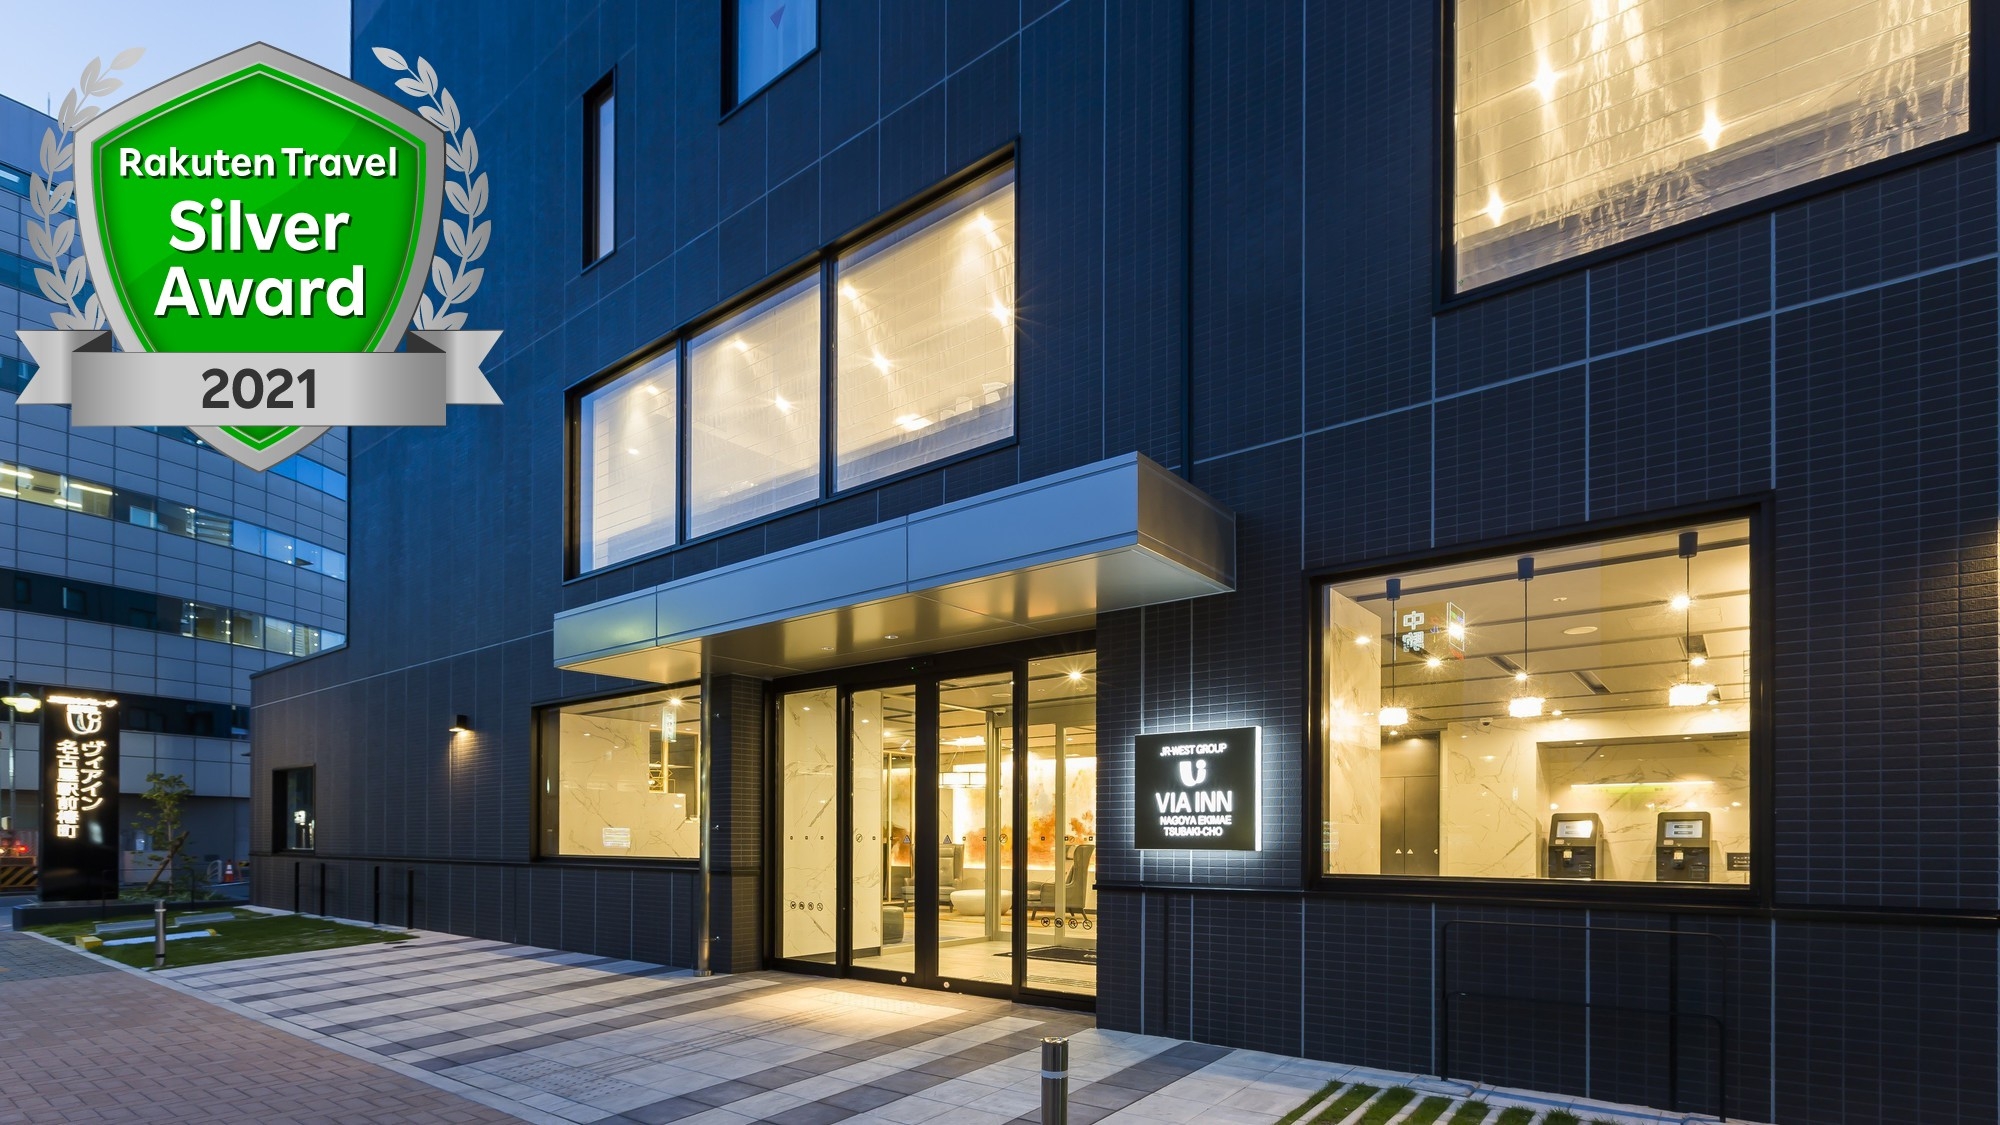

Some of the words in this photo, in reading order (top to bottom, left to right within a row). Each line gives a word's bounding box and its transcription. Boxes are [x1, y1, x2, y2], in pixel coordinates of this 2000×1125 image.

[1160, 745, 1196, 757] JR-WEST
[1196, 743, 1228, 755] GROUP
[81, 740, 107, 811] ヴィアイン
[1155, 791, 1192, 813] VIA
[1195, 790, 1233, 813] INN
[1160, 815, 1197, 826] NAGOYA
[1198, 814, 1233, 826] EKIMAE
[1163, 826, 1224, 837] TSUBAKI-CHO
